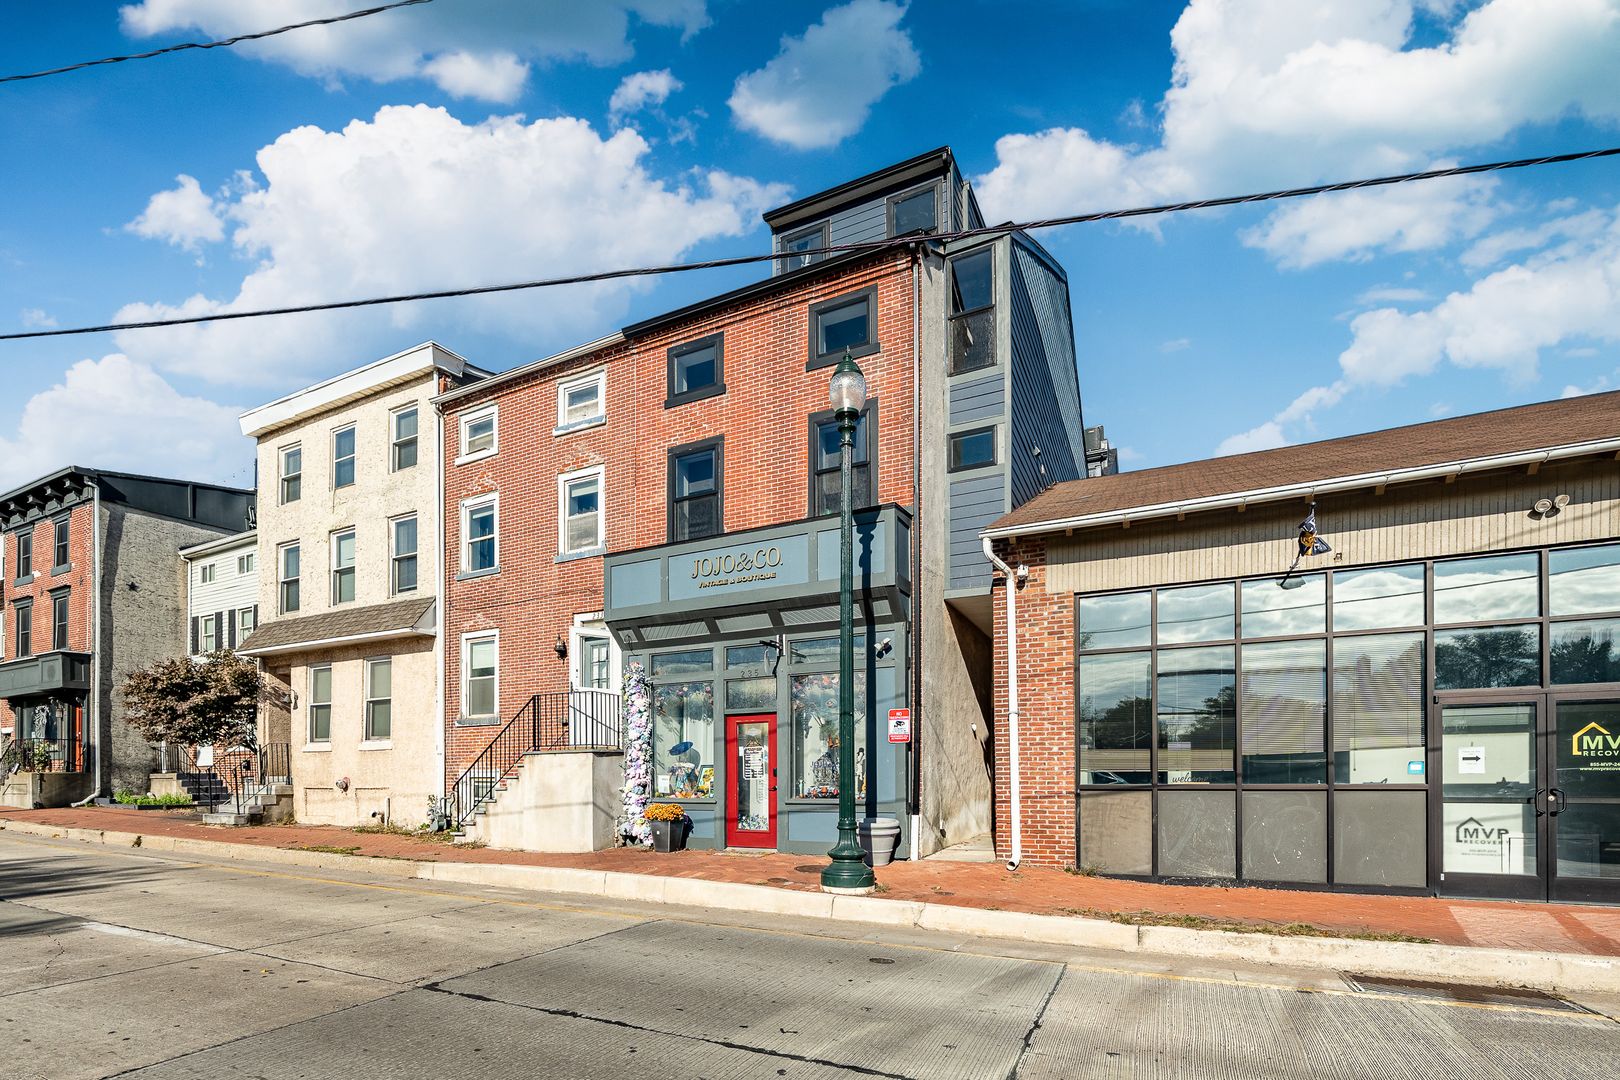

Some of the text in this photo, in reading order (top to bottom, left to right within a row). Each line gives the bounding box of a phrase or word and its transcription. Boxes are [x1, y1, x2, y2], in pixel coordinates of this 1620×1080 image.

[699, 579, 728, 589] VINTAGE
[736, 572, 776, 584] BOUTIQUE
[740, 669, 759, 678] 235
[1463, 828, 1509, 840] MVP
